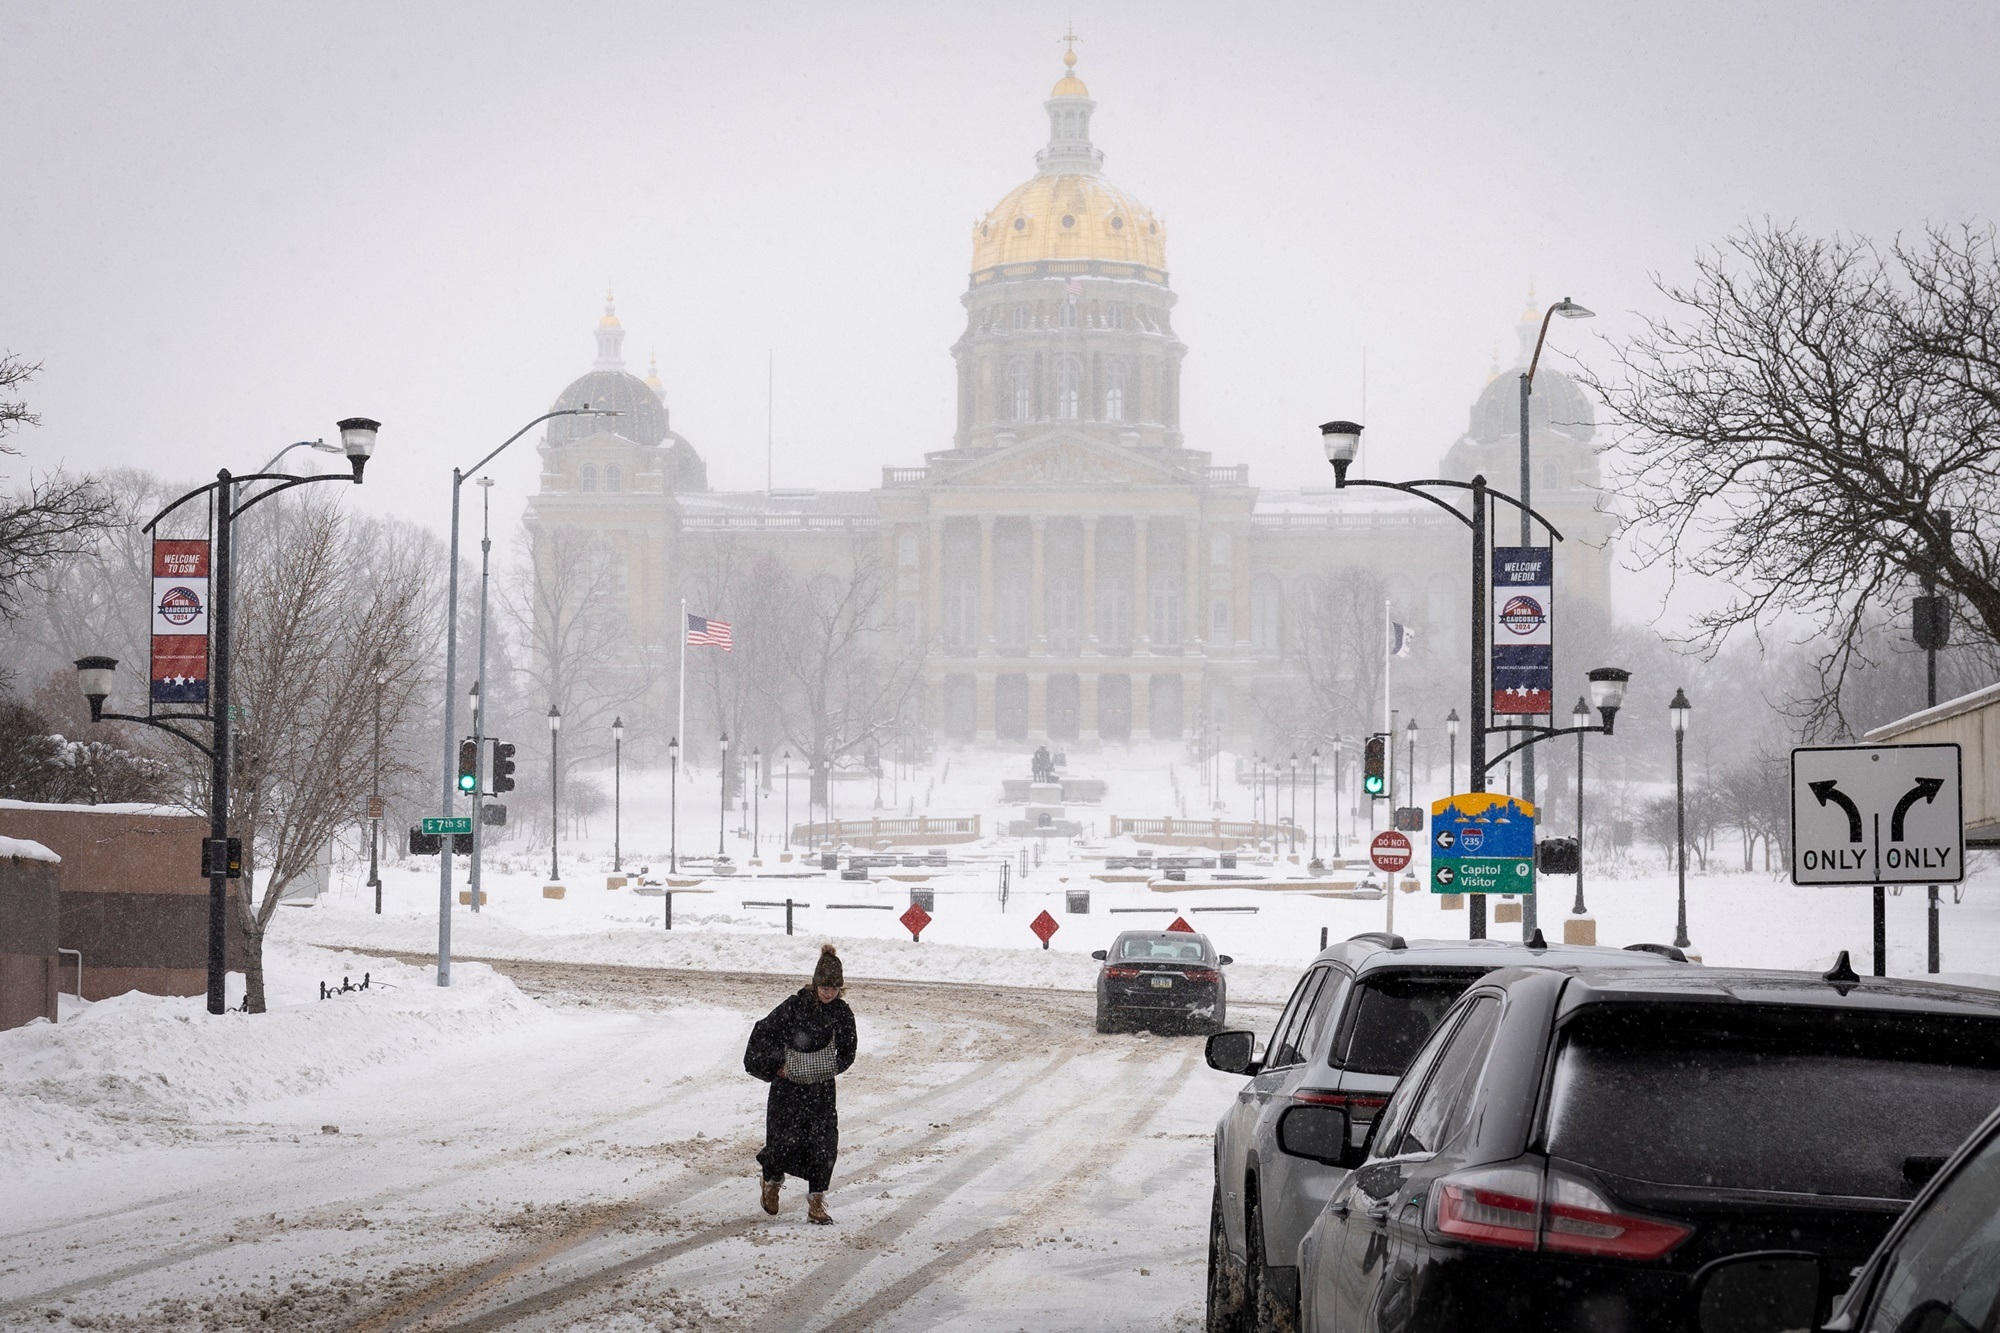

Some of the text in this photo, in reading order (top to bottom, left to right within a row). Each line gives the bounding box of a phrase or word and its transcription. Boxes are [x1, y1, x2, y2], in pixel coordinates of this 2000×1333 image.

[164, 554, 201, 564] WELCOME
[168, 564, 196, 573] TO DSM
[1504, 562, 1542, 572] WELCOME
[1511, 573, 1535, 582] MEDIA
[427, 819, 466, 832] E 7th St
[1378, 838, 1406, 847] DO NOT
[1464, 837, 1480, 846] 235
[1378, 857, 1404, 865] ENTER
[1803, 847, 1951, 870] ONLY ONLY
[1460, 864, 1501, 876] Capitol
[1519, 865, 1526, 875] P
[1461, 876, 1497, 887] Visitor
